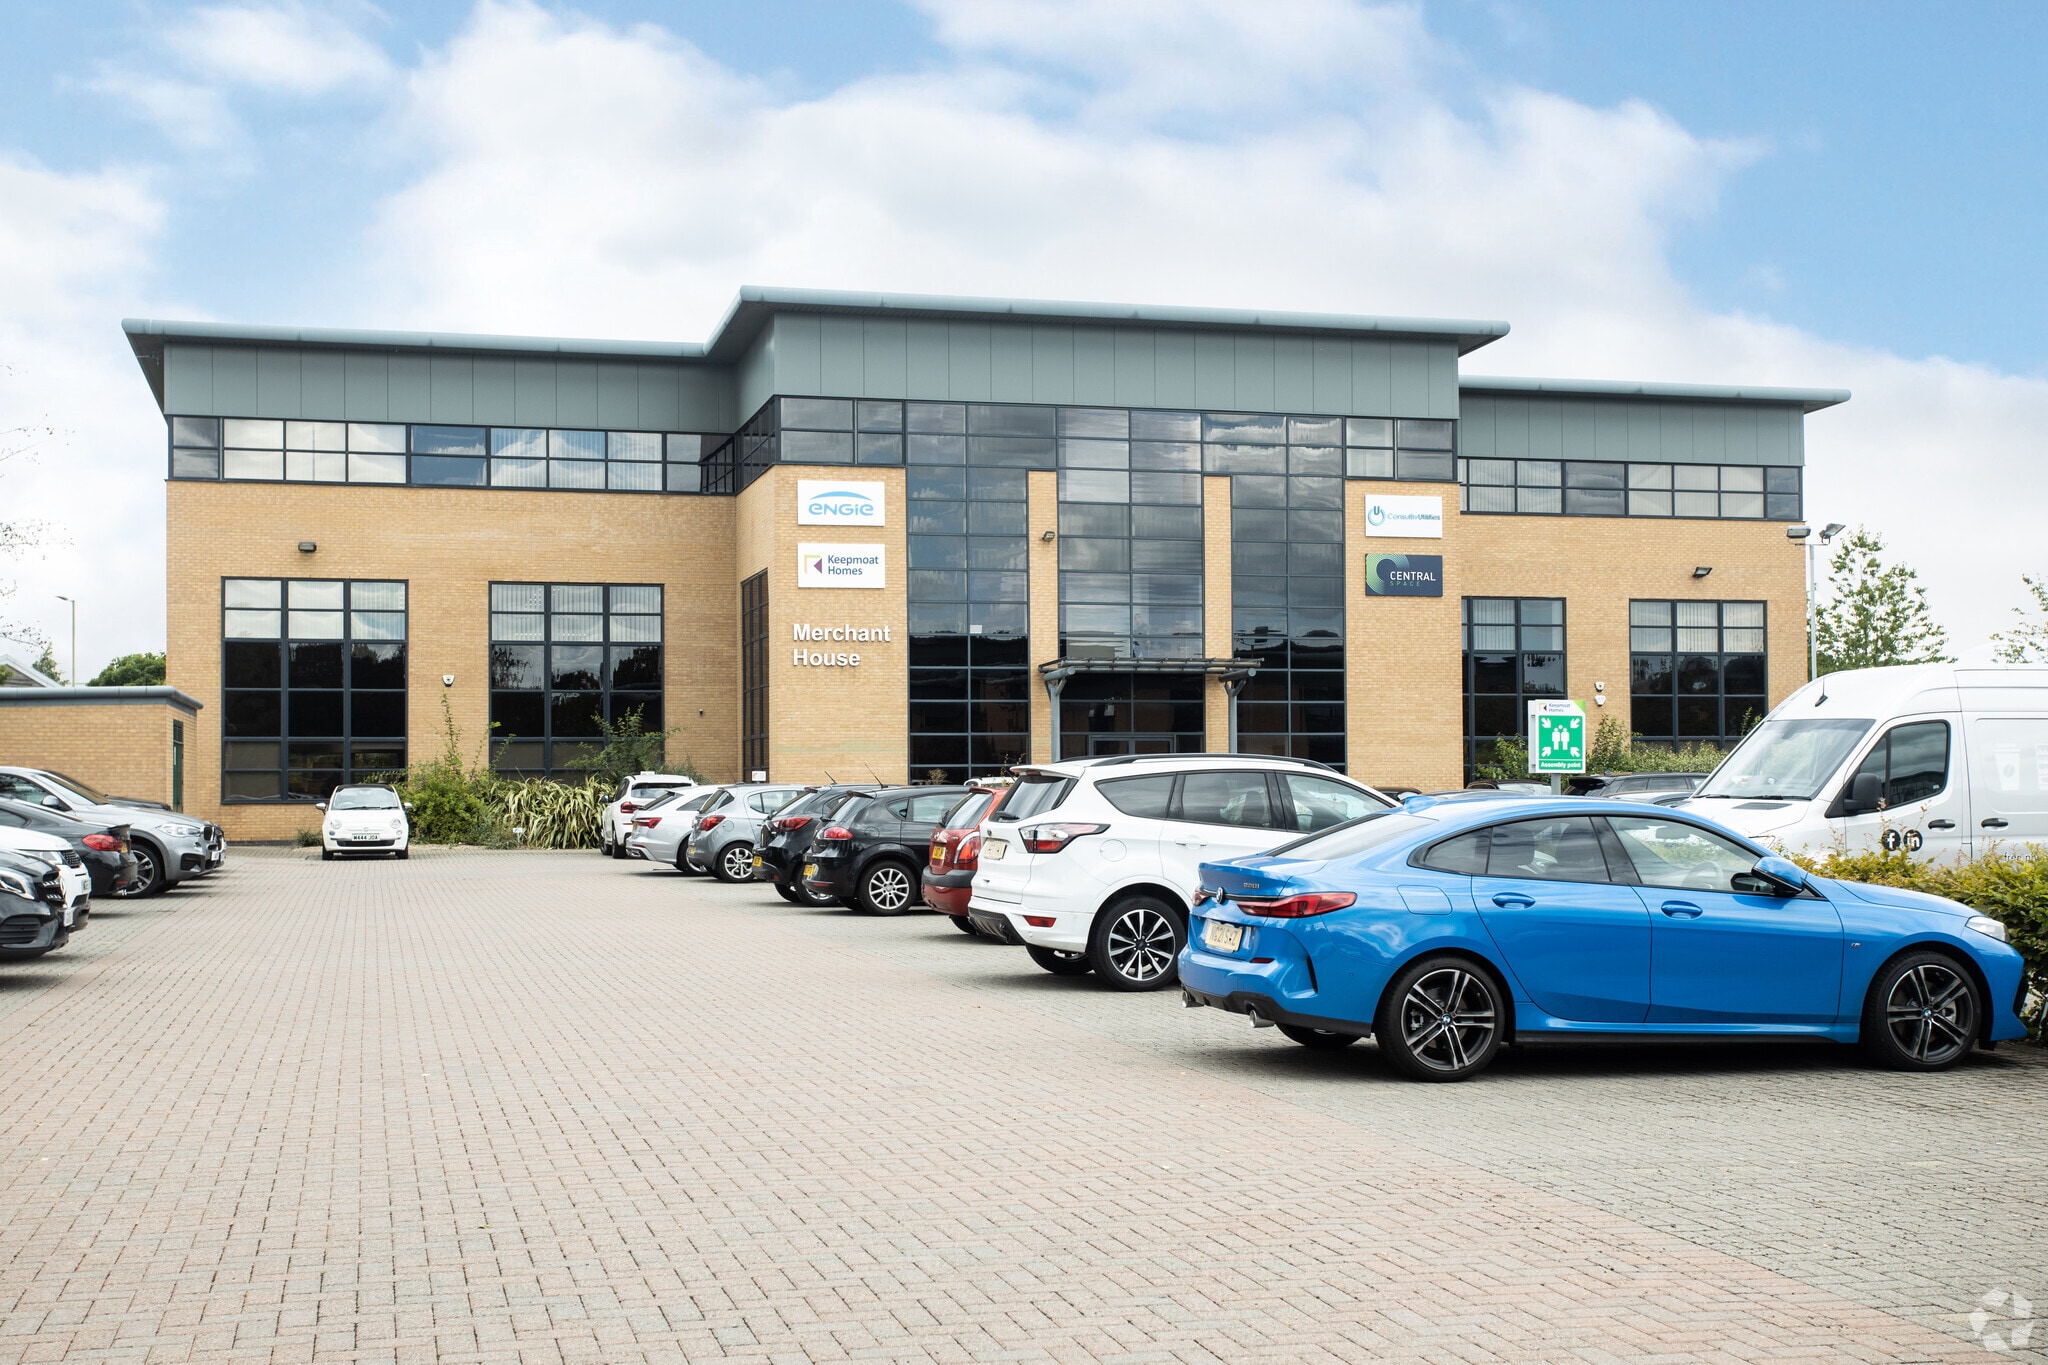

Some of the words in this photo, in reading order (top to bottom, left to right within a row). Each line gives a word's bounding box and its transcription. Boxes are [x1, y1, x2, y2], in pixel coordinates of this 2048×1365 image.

[827, 554, 879, 566] Keepmoat
[827, 565, 863, 575] Homes
[1390, 571, 1436, 581] CENTRAL
[793, 623, 891, 642] Merchant
[793, 648, 861, 666] House
